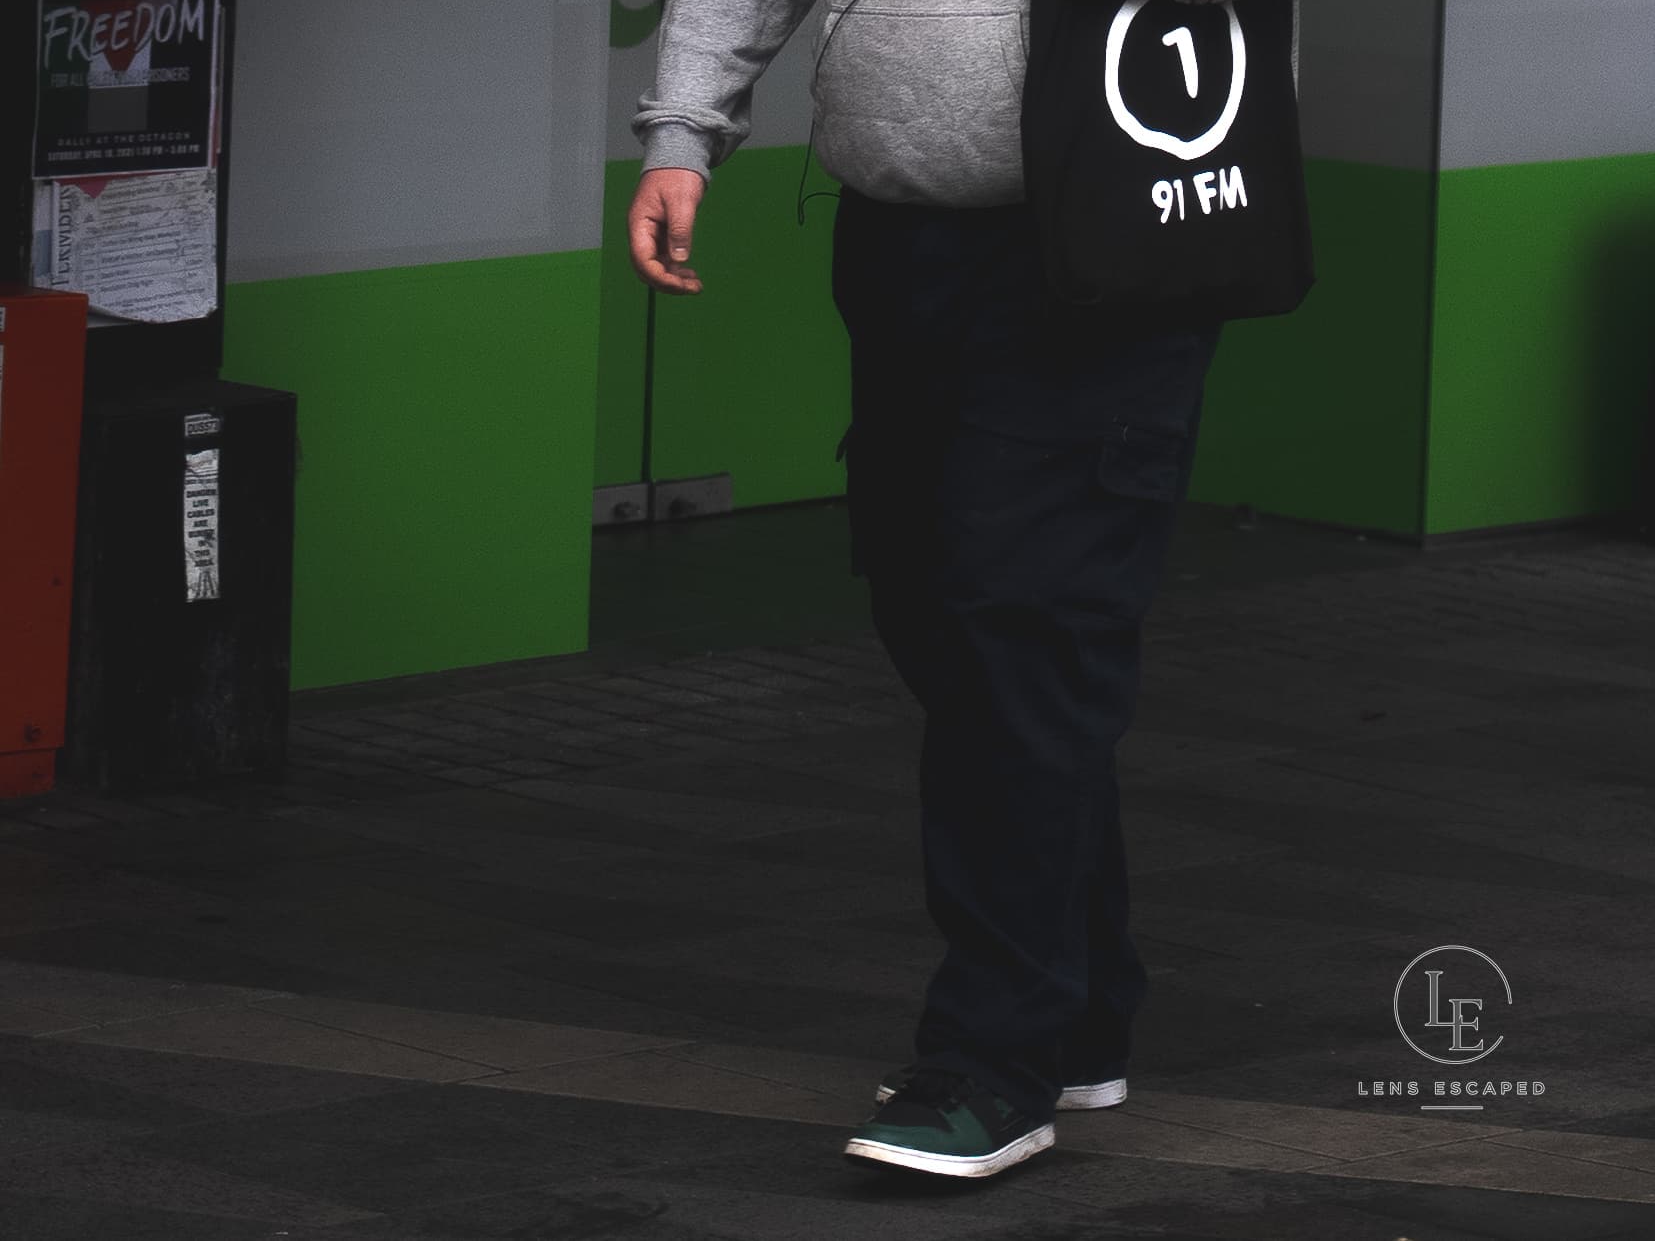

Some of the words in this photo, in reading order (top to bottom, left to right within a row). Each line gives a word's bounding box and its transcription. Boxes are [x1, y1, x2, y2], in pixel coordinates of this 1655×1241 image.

[1162, 26, 1199, 99] 1
[1151, 179, 1185, 224] 91
[1192, 164, 1248, 215] FM
[187, 509, 215, 518] CABLES
